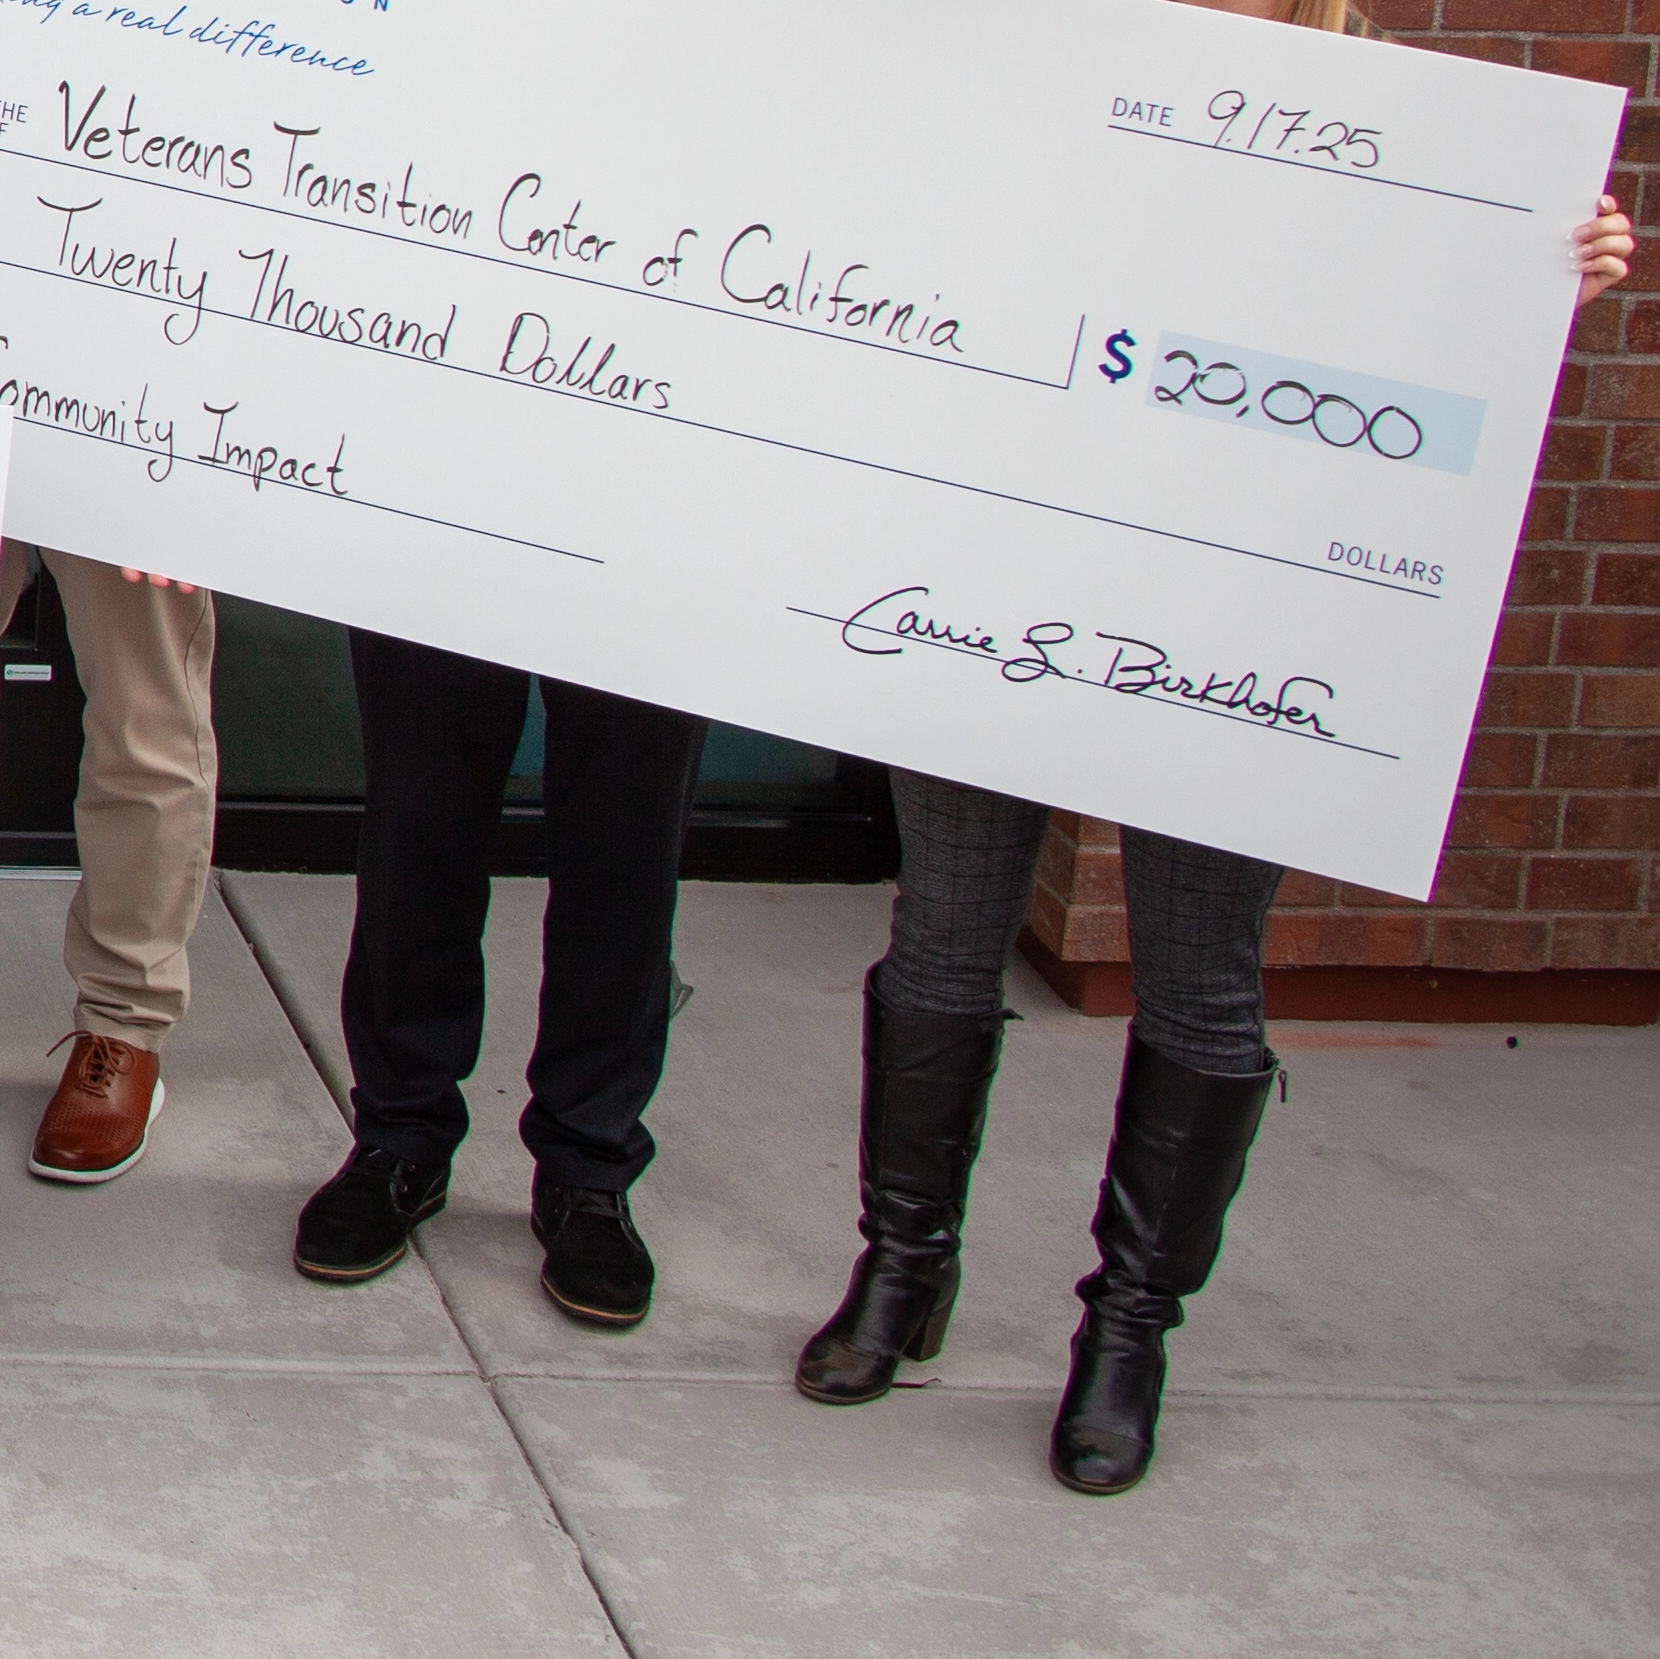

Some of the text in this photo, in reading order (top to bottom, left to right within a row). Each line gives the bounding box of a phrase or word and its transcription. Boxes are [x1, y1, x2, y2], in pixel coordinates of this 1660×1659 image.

[73, 0, 105, 15] a
[106, 5, 188, 36] real
[189, 21, 375, 77] difference
[1112, 97, 1173, 126] DATE
[58, 80, 964, 354] Veterans Transition Center of California
[37, 196, 671, 410] Twenty Thousand Dollars
[198, 401, 348, 495] Impact
[1154, 350, 1422, 459] 20,000
[1328, 542, 1444, 586] DOLLARS
